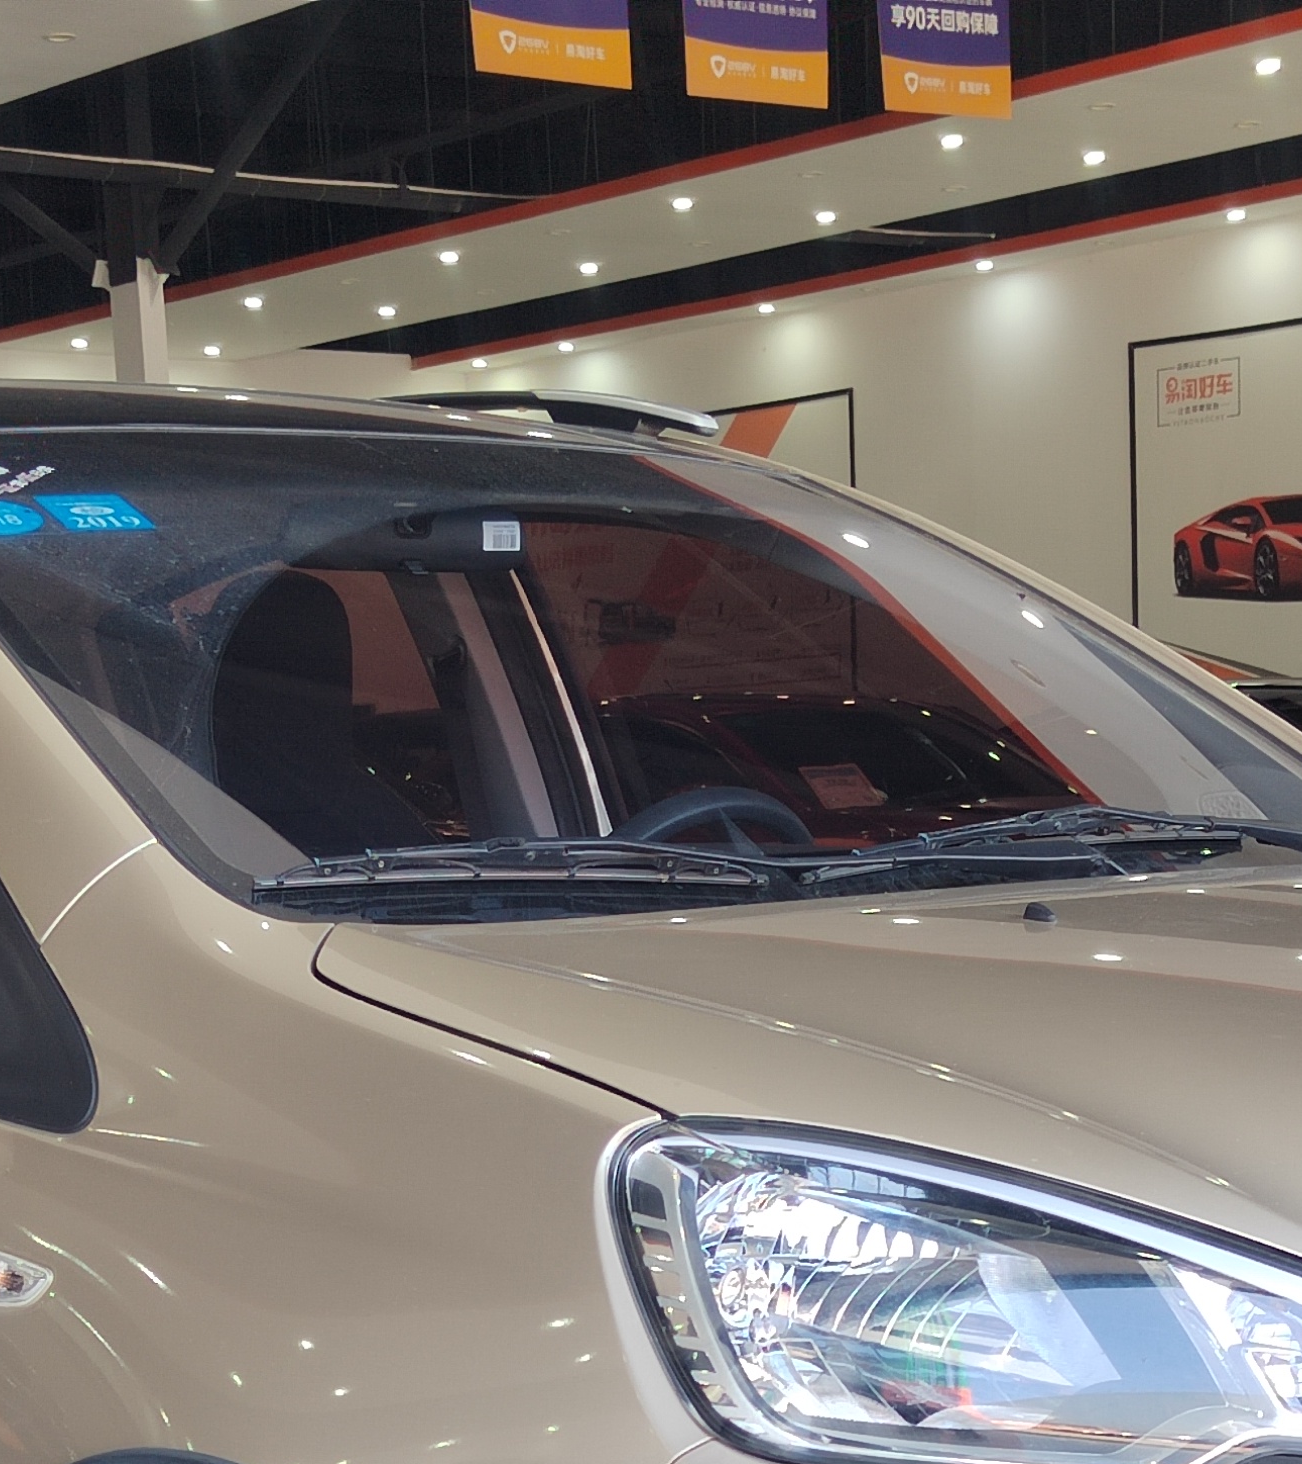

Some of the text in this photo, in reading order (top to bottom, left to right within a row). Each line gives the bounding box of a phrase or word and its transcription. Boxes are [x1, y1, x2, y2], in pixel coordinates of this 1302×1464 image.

[889, 4, 999, 37] 享90天回购保障
[1164, 372, 1233, 405] 易淘好车
[68, 515, 141, 529] 2019
